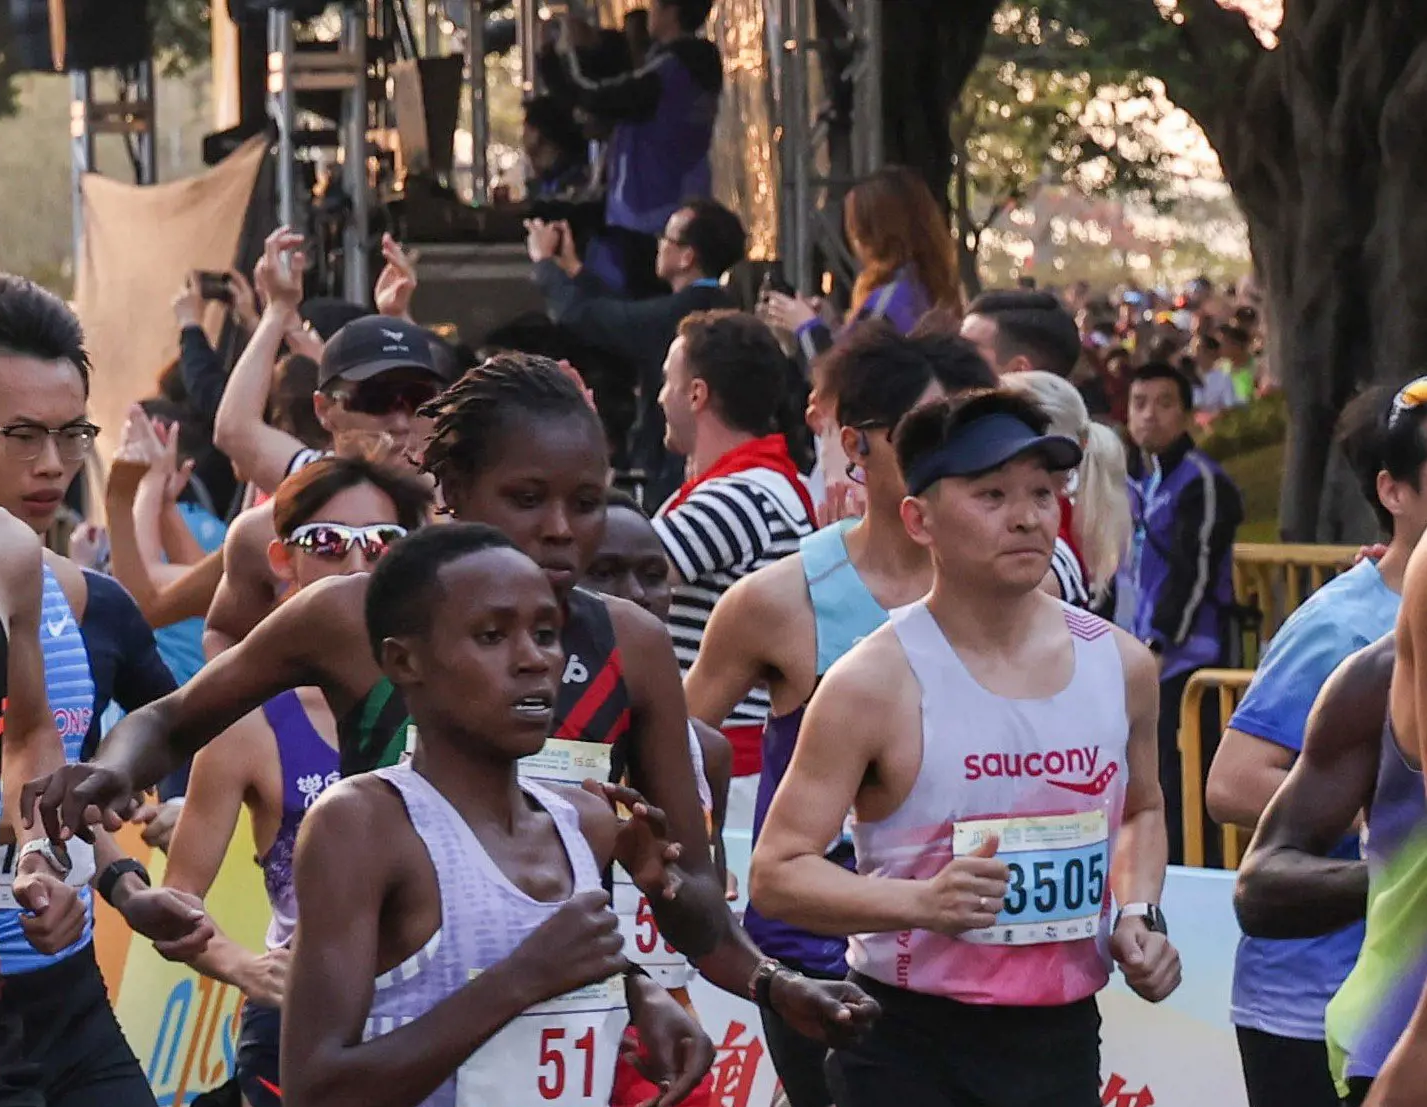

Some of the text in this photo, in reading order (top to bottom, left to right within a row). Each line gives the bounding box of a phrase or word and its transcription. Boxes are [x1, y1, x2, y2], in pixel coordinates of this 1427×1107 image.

[964, 745, 1099, 781] saucony
[1002, 852, 1104, 916] 3505
[635, 896, 677, 954] 5
[537, 1026, 595, 1101] 51
